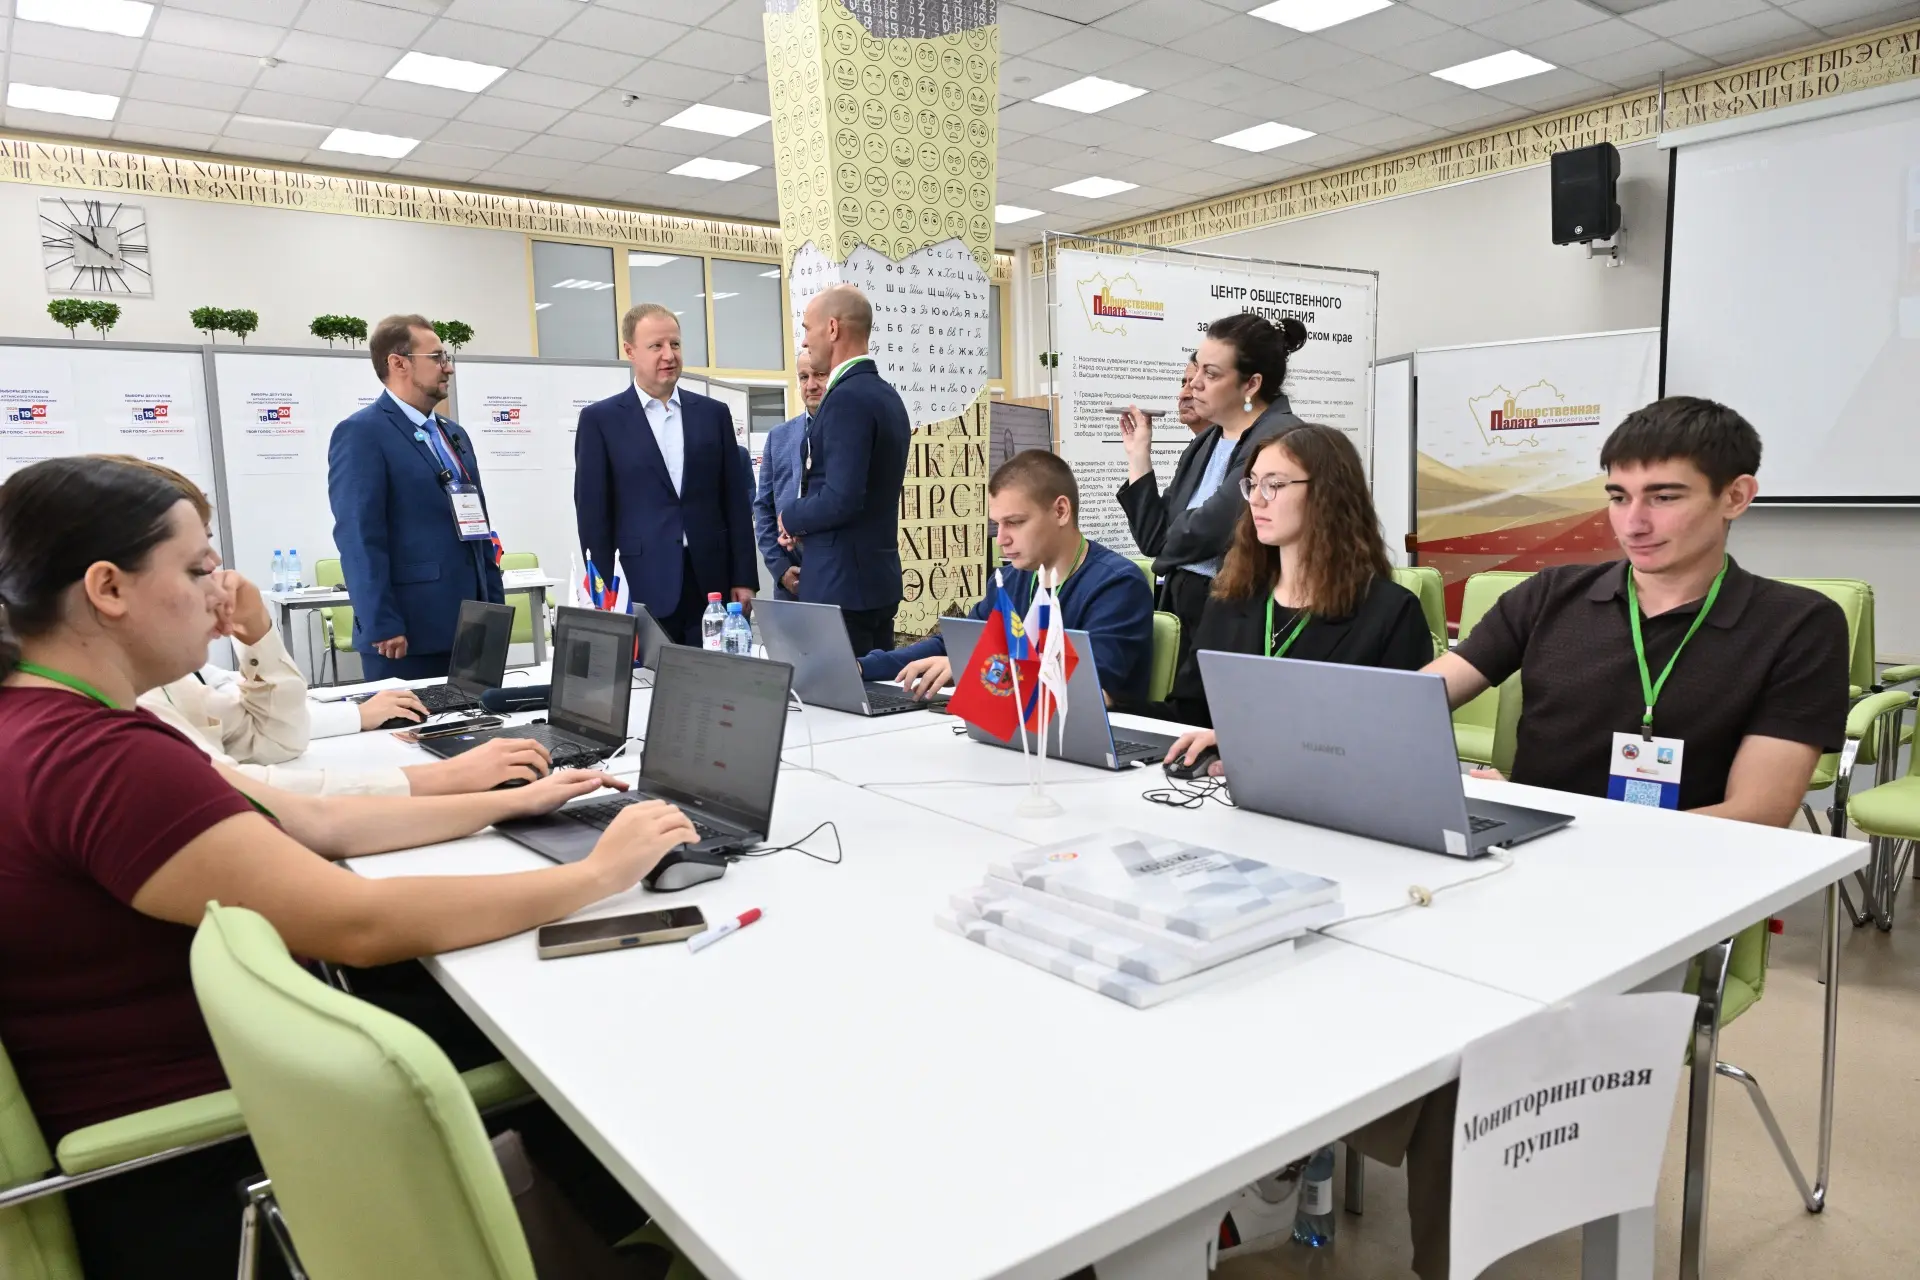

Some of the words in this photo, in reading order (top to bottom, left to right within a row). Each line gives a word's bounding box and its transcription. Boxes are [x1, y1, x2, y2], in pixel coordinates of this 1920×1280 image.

[1211, 284, 1247, 300] ЦЕНТР
[1250, 289, 1342, 310] ОБЩЕСТВЕННОГО
[1332, 332, 1353, 344] крае
[9, 414, 19, 422] 18
[1504, 399, 1600, 419] Общественная
[1491, 410, 1538, 430] Палата
[1463, 1068, 1653, 1146] Мониторинговая
[1504, 1122, 1580, 1169] группа
